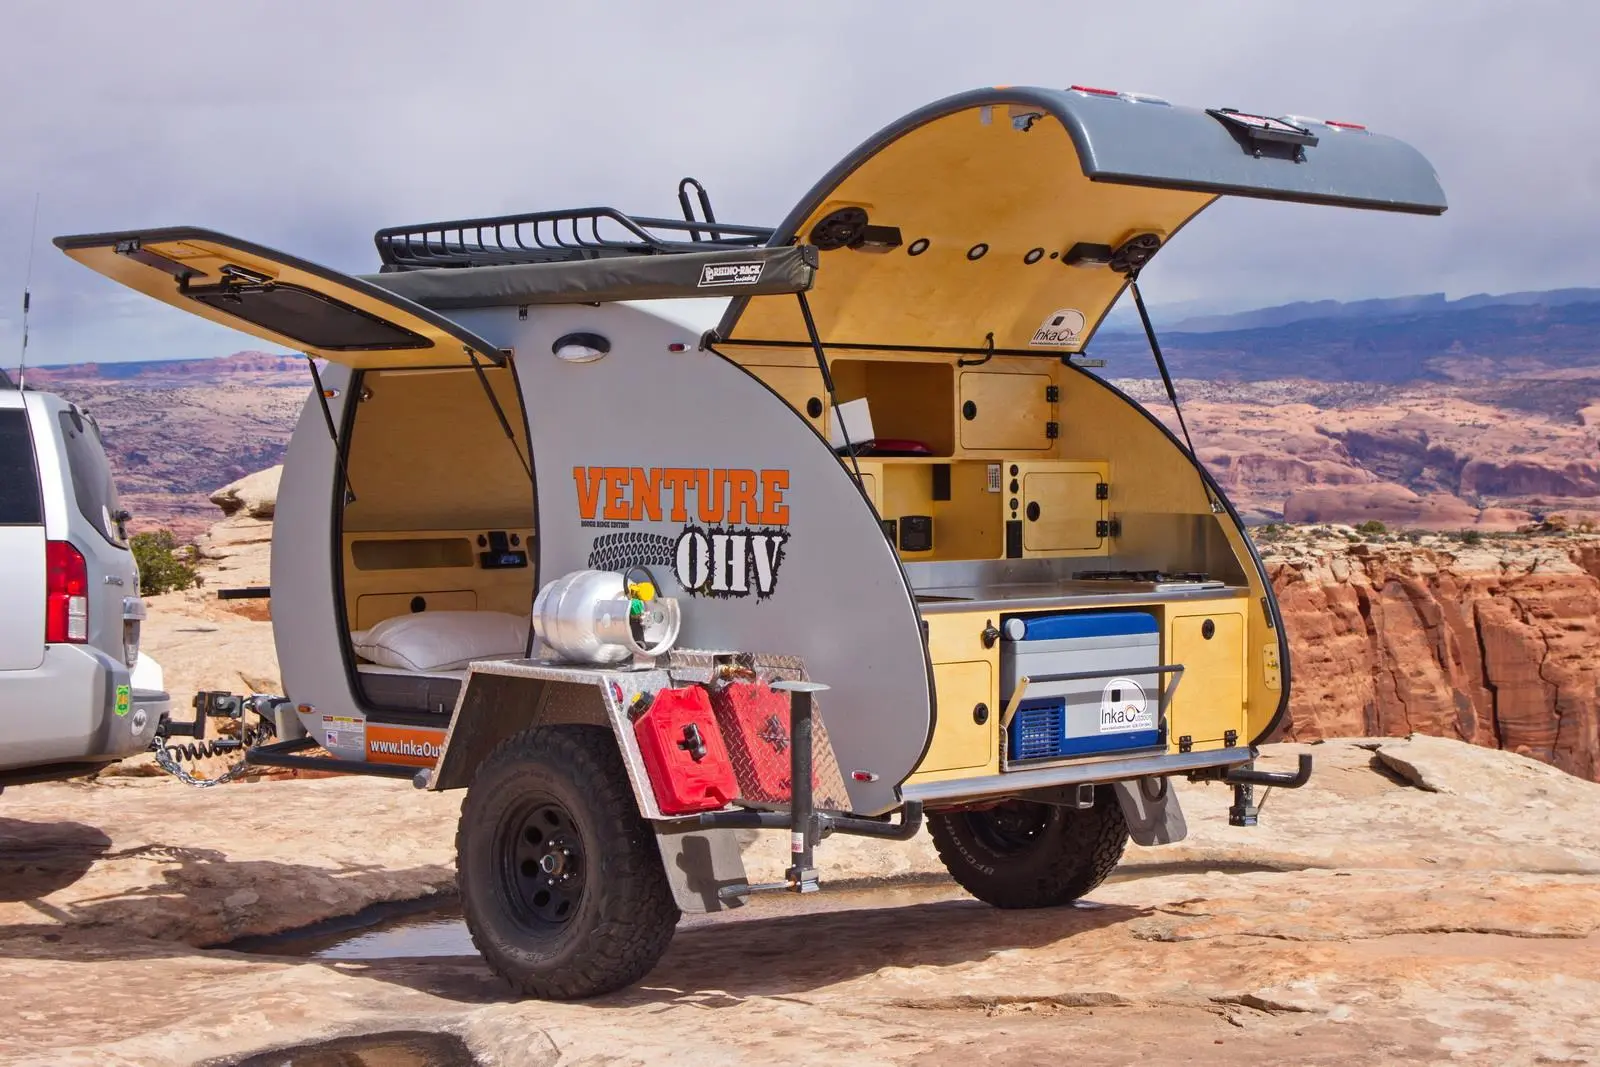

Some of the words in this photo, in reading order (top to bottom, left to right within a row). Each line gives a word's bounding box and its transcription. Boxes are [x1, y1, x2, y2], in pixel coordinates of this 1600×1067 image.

[713, 265, 761, 276] RHINO-RACK
[573, 467, 789, 525] VENTURE
[674, 527, 788, 596] OHV
[944, 815, 994, 875] BFGoodr
